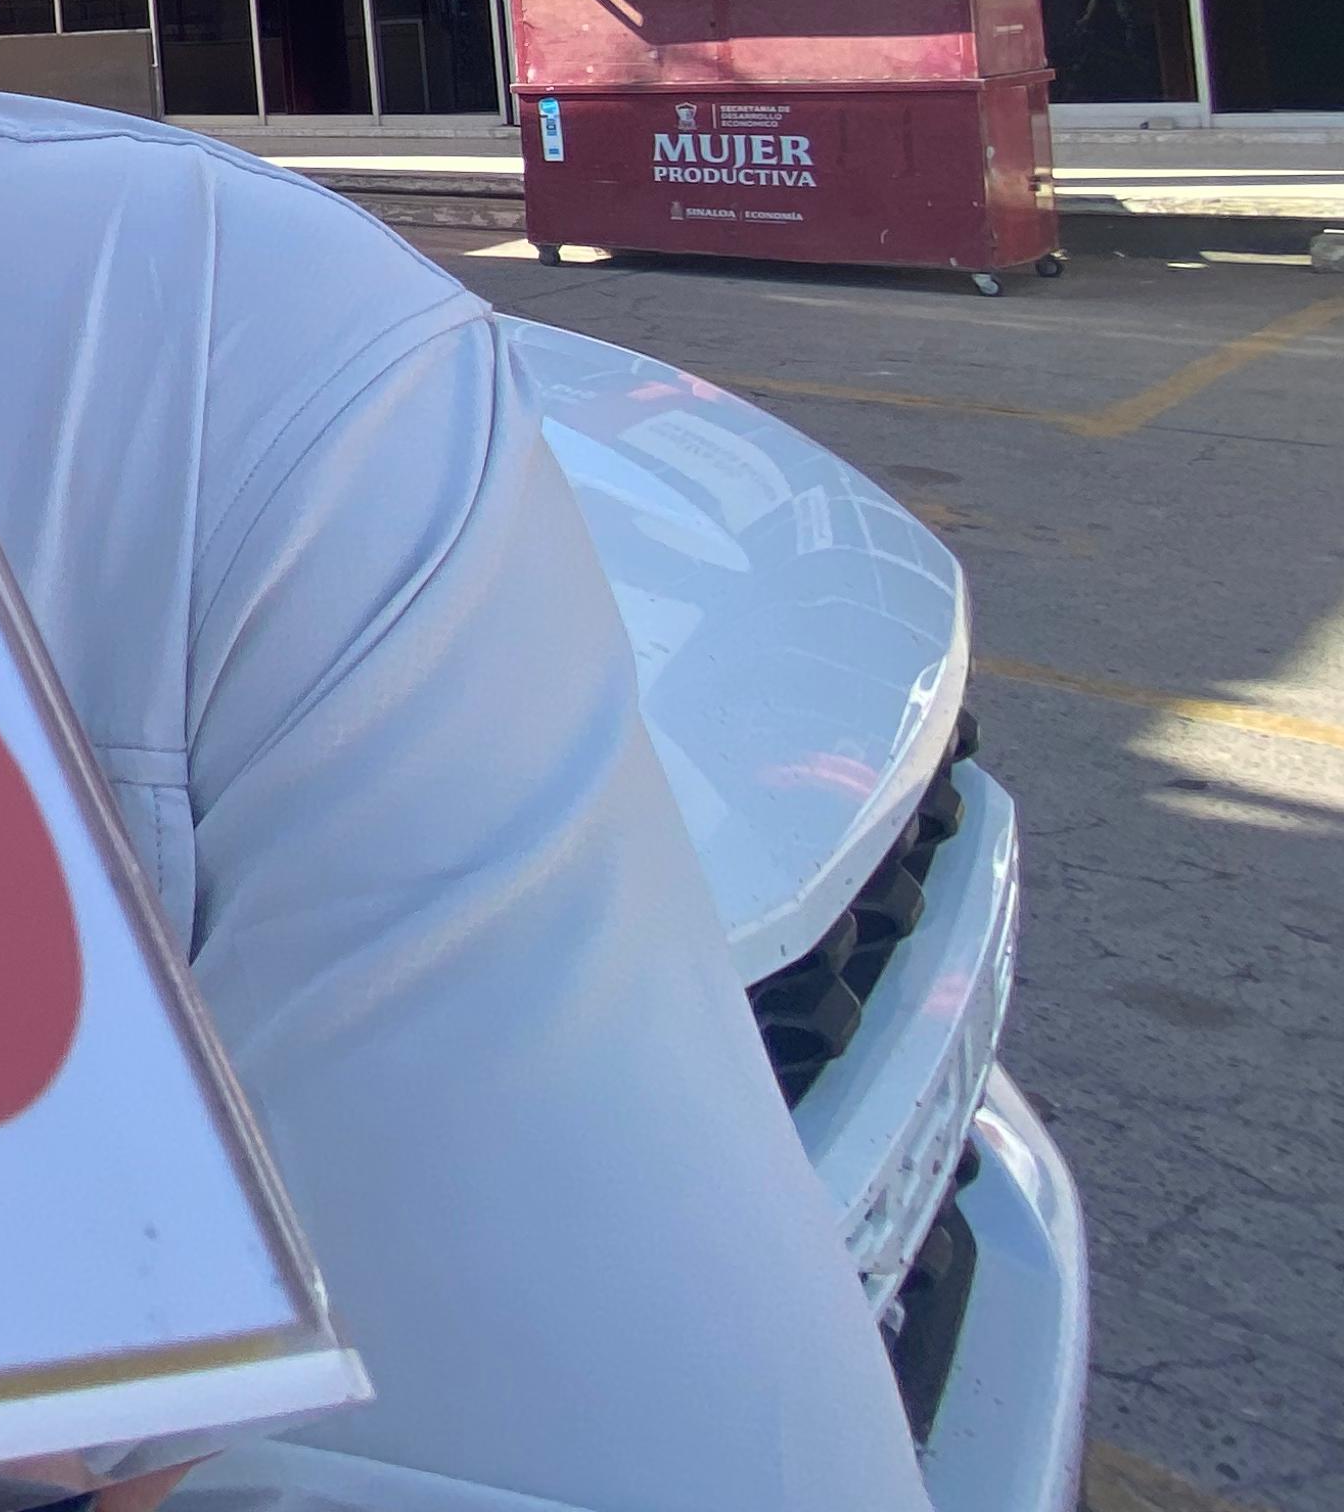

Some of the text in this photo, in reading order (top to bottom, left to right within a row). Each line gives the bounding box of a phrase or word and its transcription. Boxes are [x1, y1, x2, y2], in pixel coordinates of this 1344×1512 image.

[653, 133, 814, 169] MUJER
[653, 166, 817, 188] PRODUCTIVA
[685, 207, 737, 219] SINALOA
